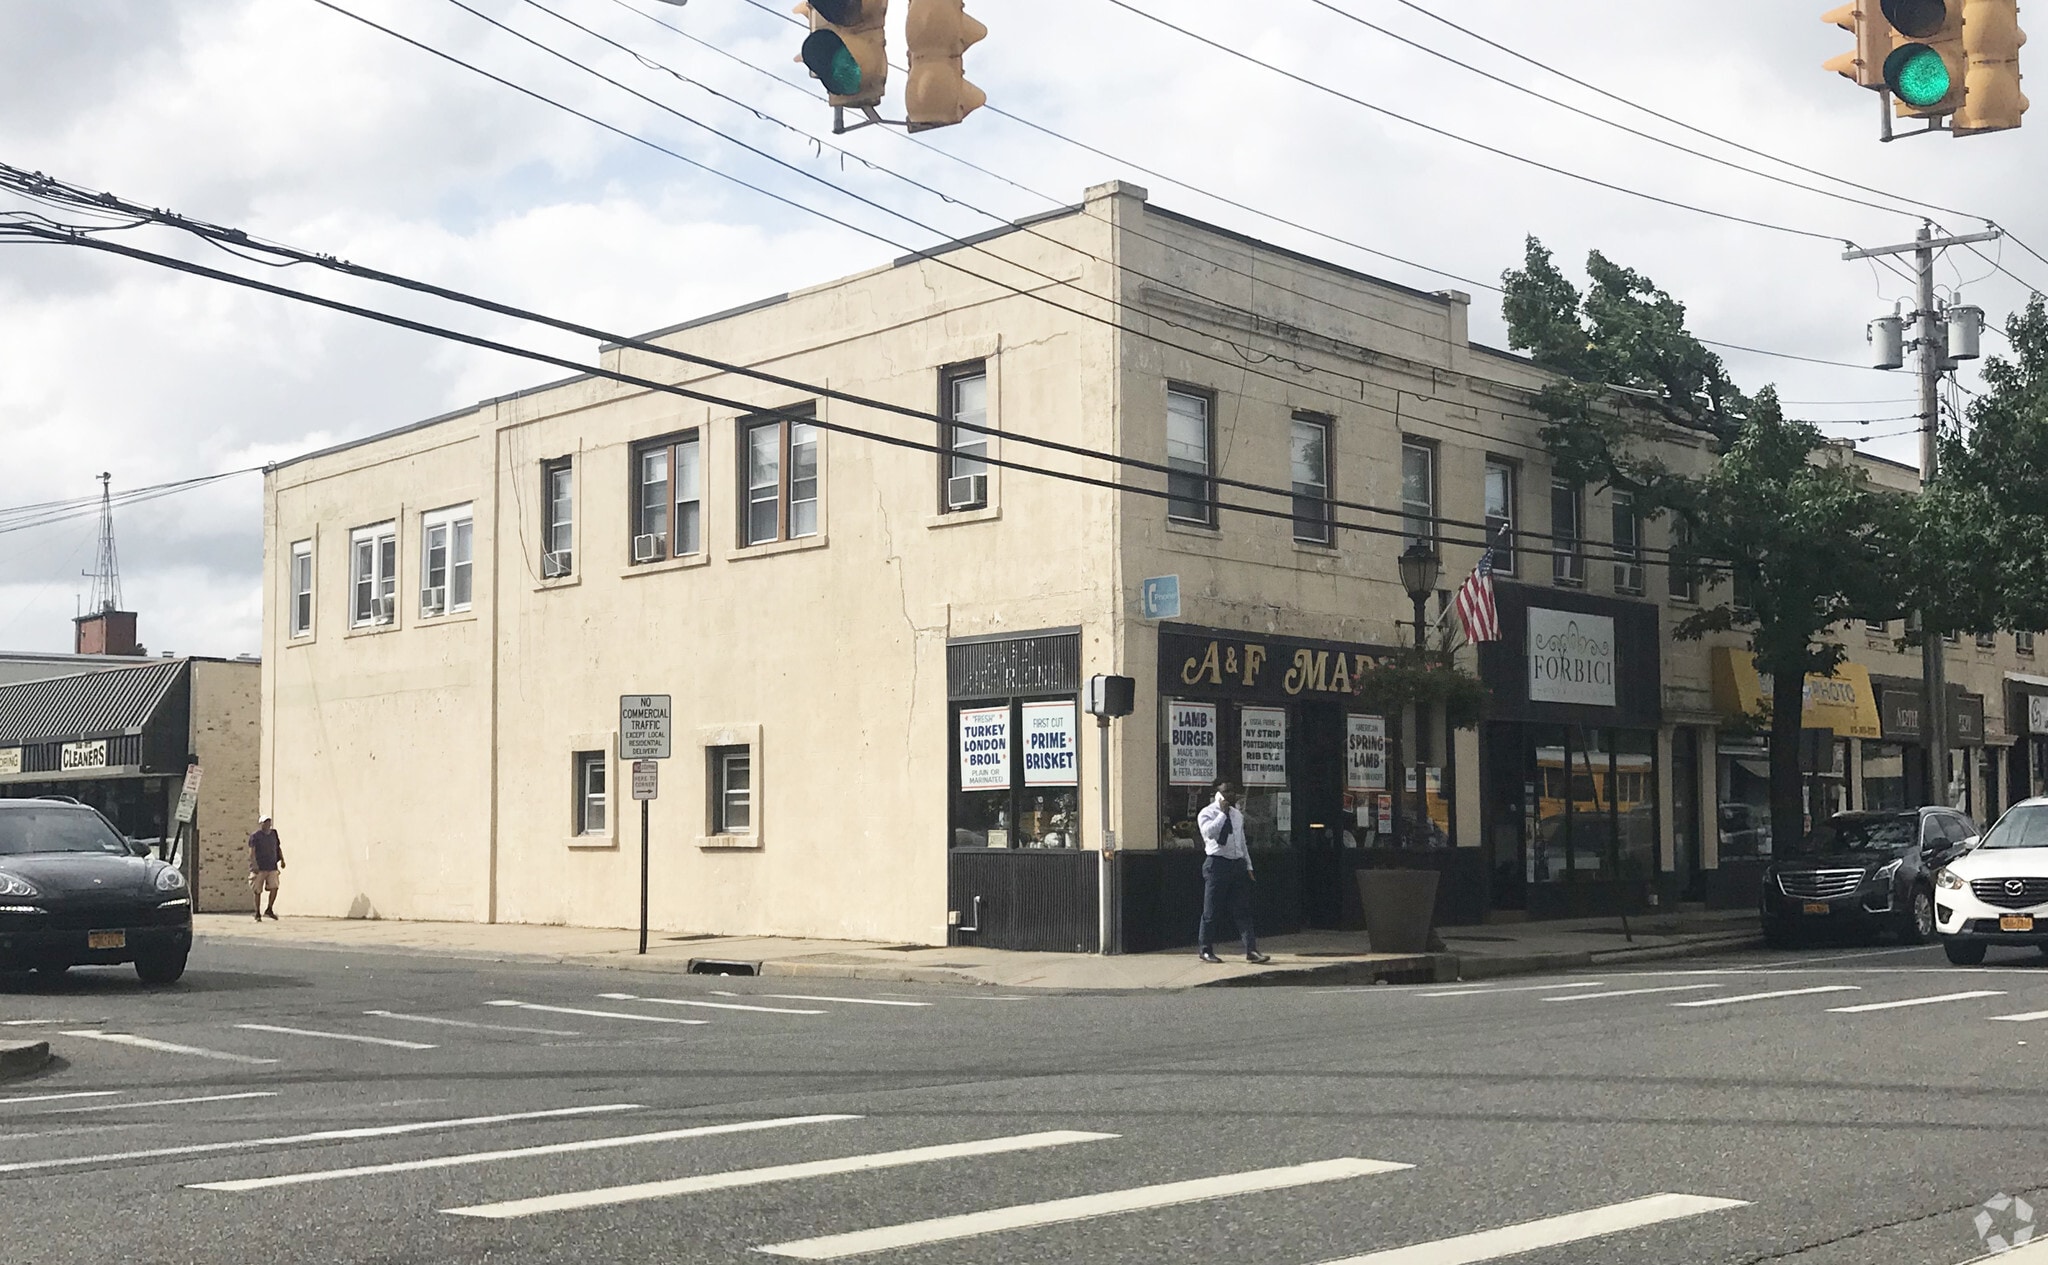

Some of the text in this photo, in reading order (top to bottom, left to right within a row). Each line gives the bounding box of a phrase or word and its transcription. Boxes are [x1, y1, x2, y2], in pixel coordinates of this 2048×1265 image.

[1181, 641, 1222, 685] A
[1226, 646, 1238, 673] &
[1242, 644, 1266, 686] F
[1534, 655, 1611, 685] FORBICI
[640, 698, 651, 707] NO
[623, 709, 668, 718] COMMERCIAL
[631, 720, 660, 729] TRAFFIC
[1033, 718, 1064, 728] FIRST CUT
[1179, 711, 1208, 728] LAMB
[964, 724, 1005, 738] TURKEY
[1246, 729, 1281, 738] NY STRIP
[1031, 732, 1066, 749] PRIME
[1172, 730, 1214, 746] BURGER
[1350, 734, 1384, 751] SPRING
[964, 738, 1006, 752] LONDON
[1243, 740, 1284, 750] PORTERHOUSE
[63, 745, 105, 768] CLEANERS
[1177, 749, 1208, 757] MADE WITH
[1246, 752, 1280, 761] RIB EYE
[970, 753, 1001, 766] BROIL
[1026, 752, 1073, 769] BRISKET
[1173, 758, 1187, 766] BABY
[1354, 752, 1380, 768] LAMB
[1179, 768, 1191, 776] FETA
[1193, 768, 1214, 776] CHEESE
[1243, 763, 1284, 772] FILET MIGNON
[969, 776, 1003, 784] MARINATED
